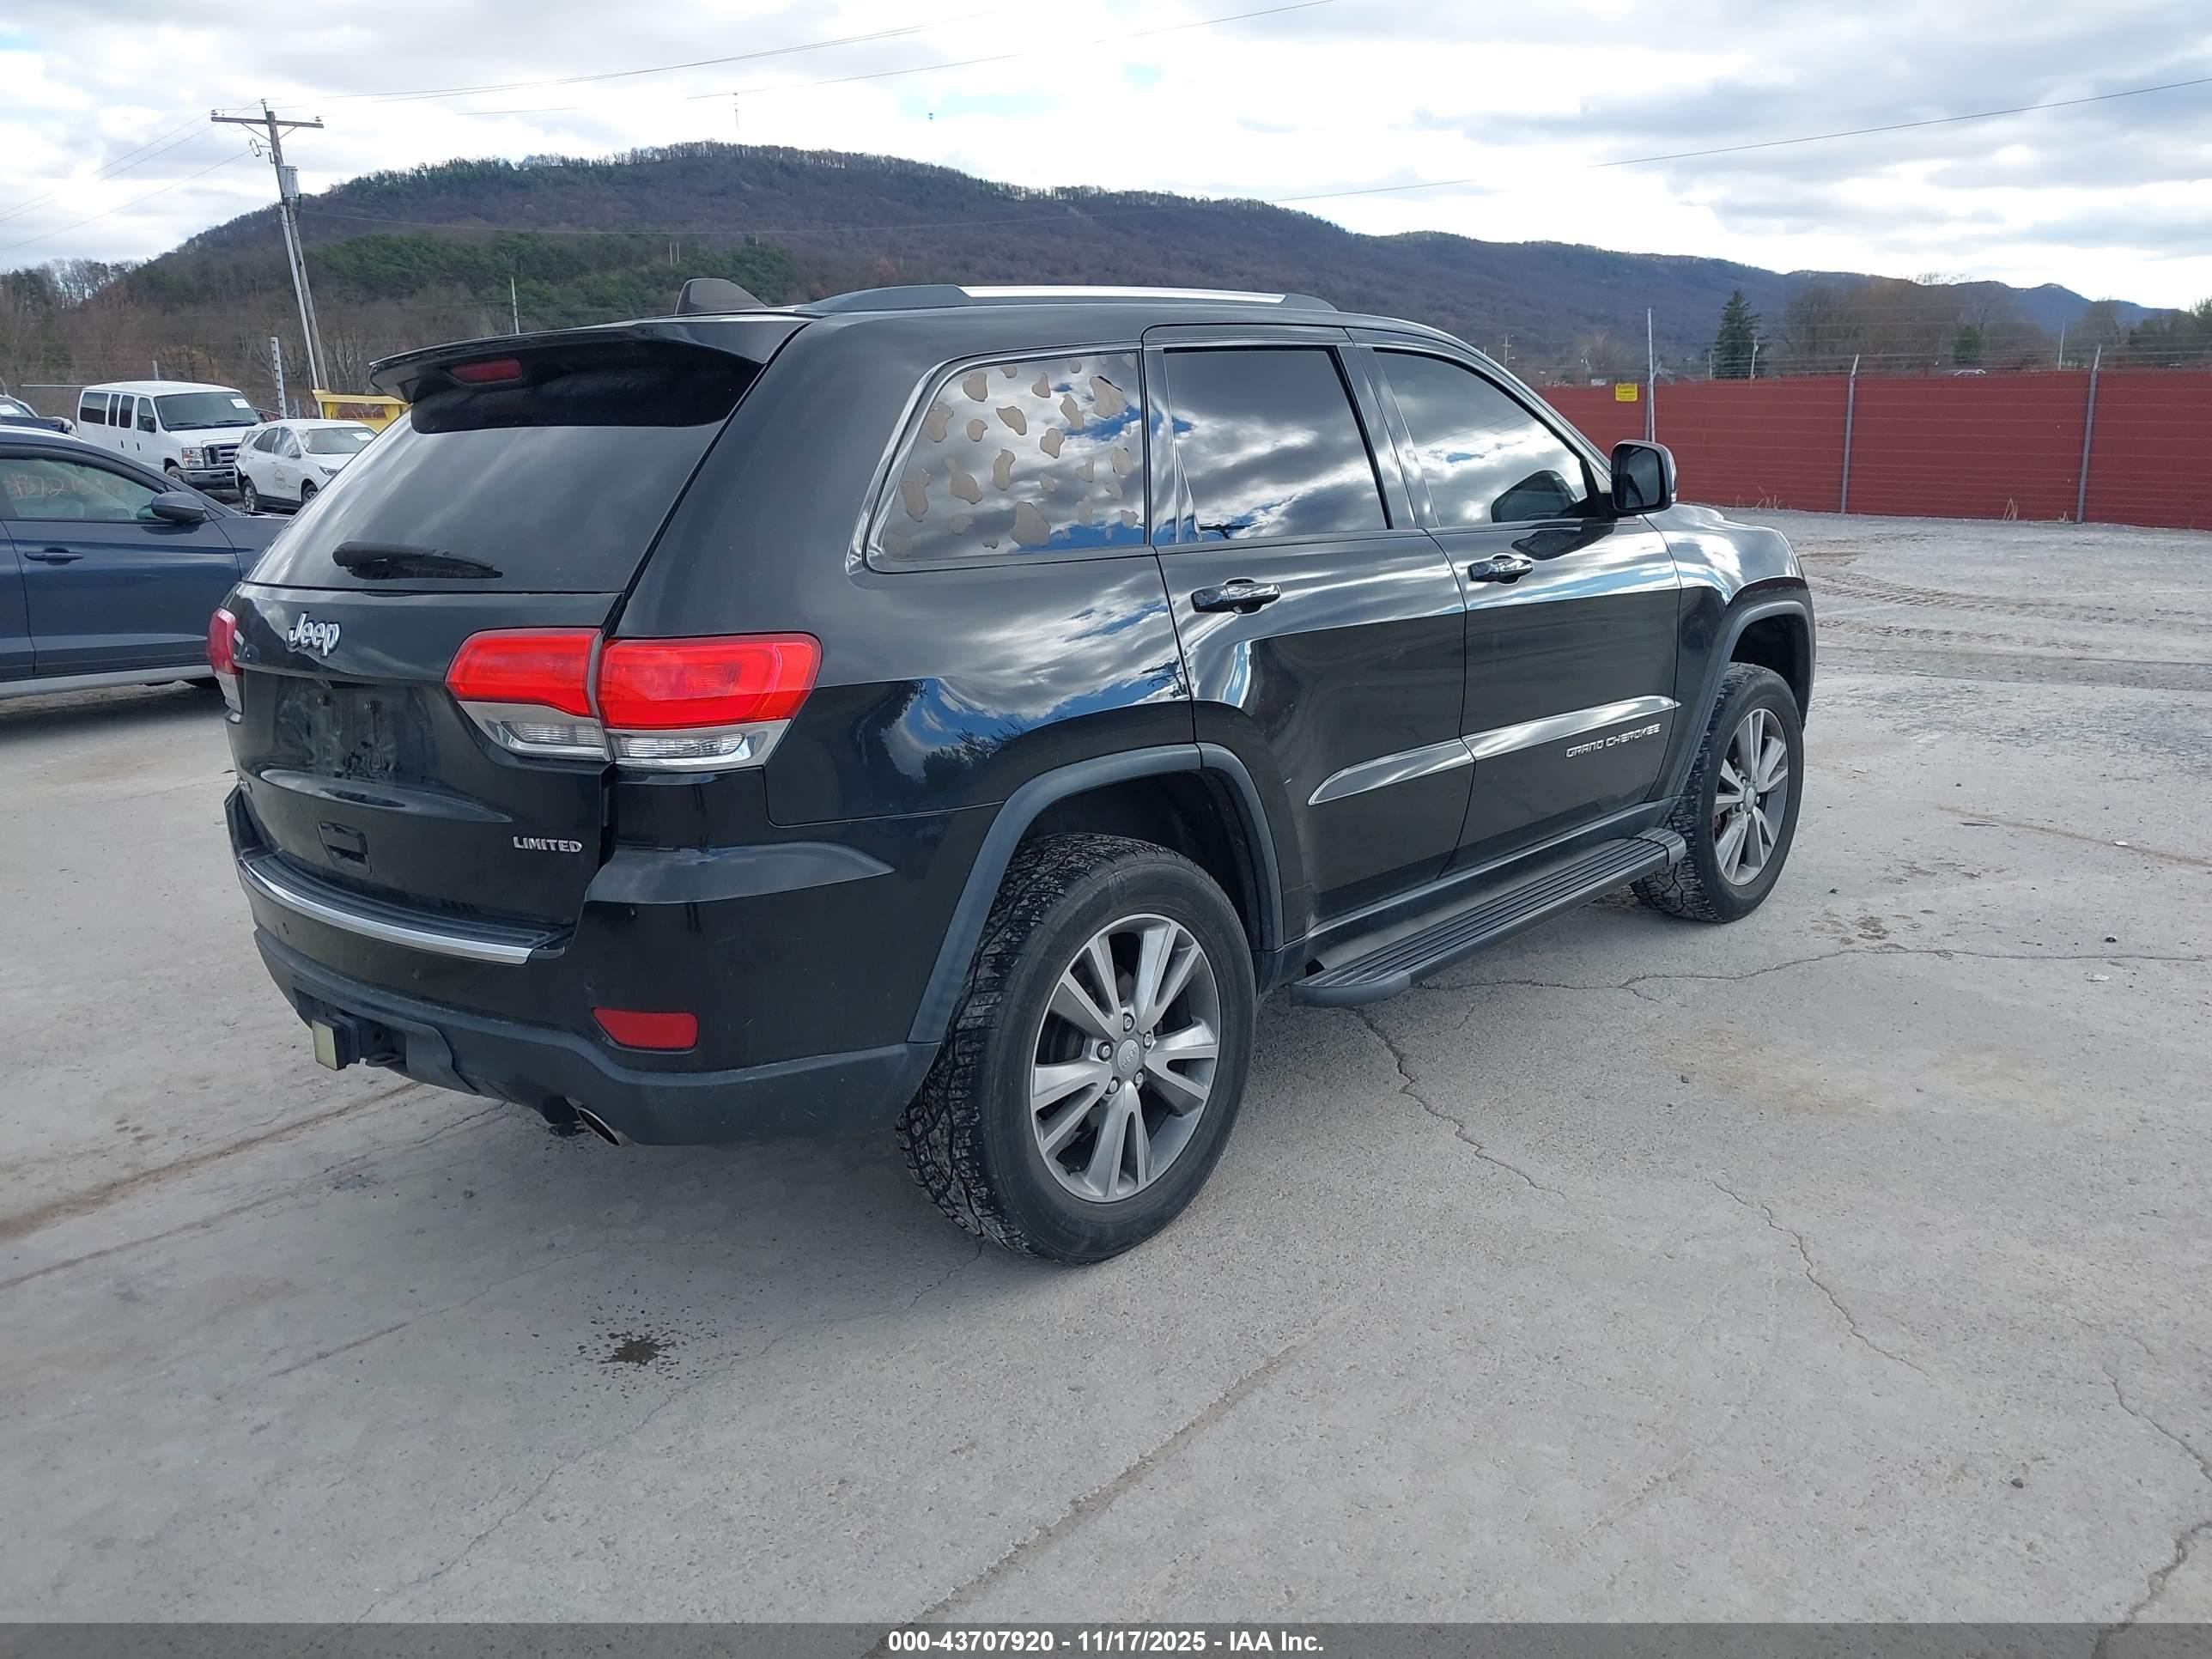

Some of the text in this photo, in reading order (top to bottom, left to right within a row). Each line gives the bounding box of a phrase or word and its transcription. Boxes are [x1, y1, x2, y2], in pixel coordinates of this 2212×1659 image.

[288, 612, 340, 657] Jeep
[1565, 723, 1661, 757] GRAND CHEROKEE
[513, 836, 582, 853] LIMITED
